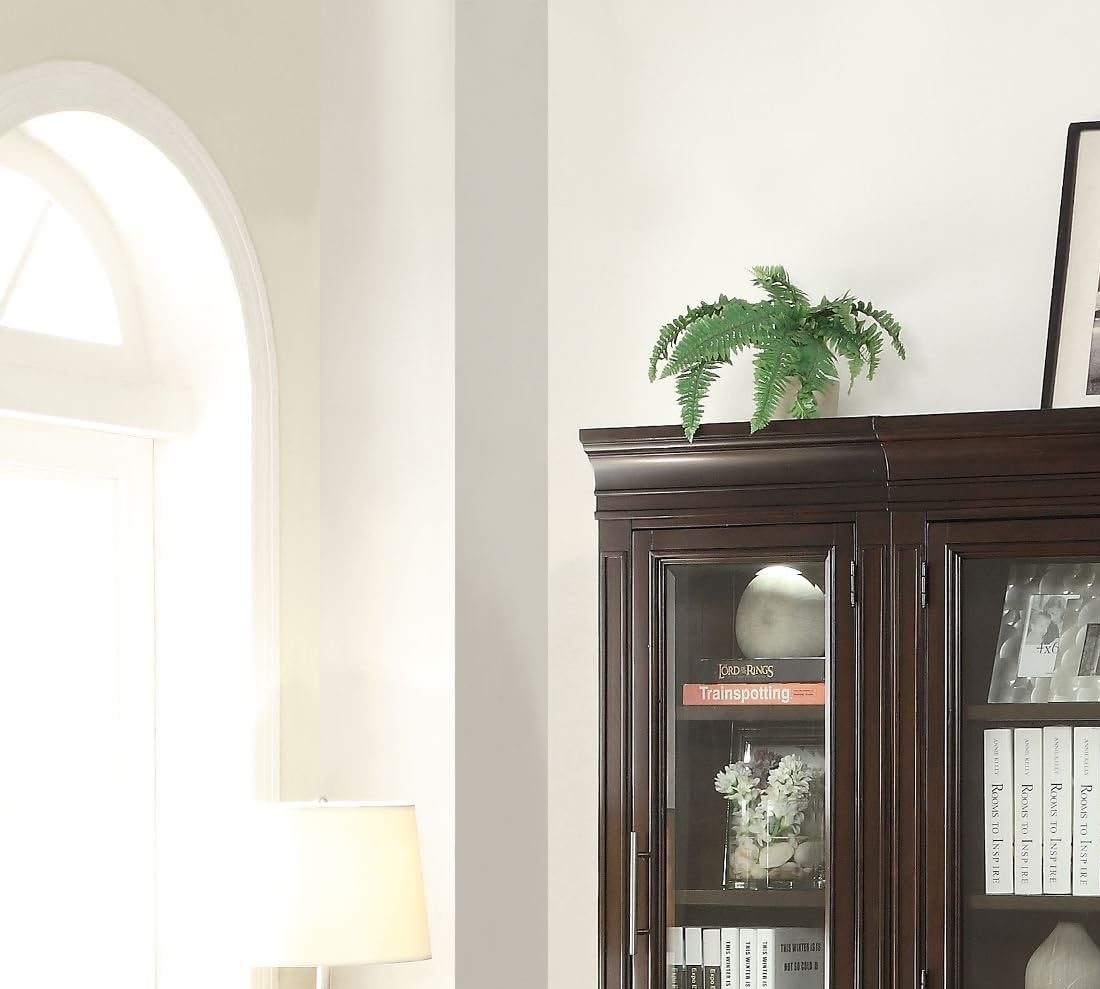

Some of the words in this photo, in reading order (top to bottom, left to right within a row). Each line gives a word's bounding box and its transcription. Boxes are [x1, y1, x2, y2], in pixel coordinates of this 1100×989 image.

[1036, 642, 1060, 654] 4x6
[718, 663, 740, 680] LORD
[746, 664, 774, 678] RINGS
[690, 967, 698, 984] Expo
